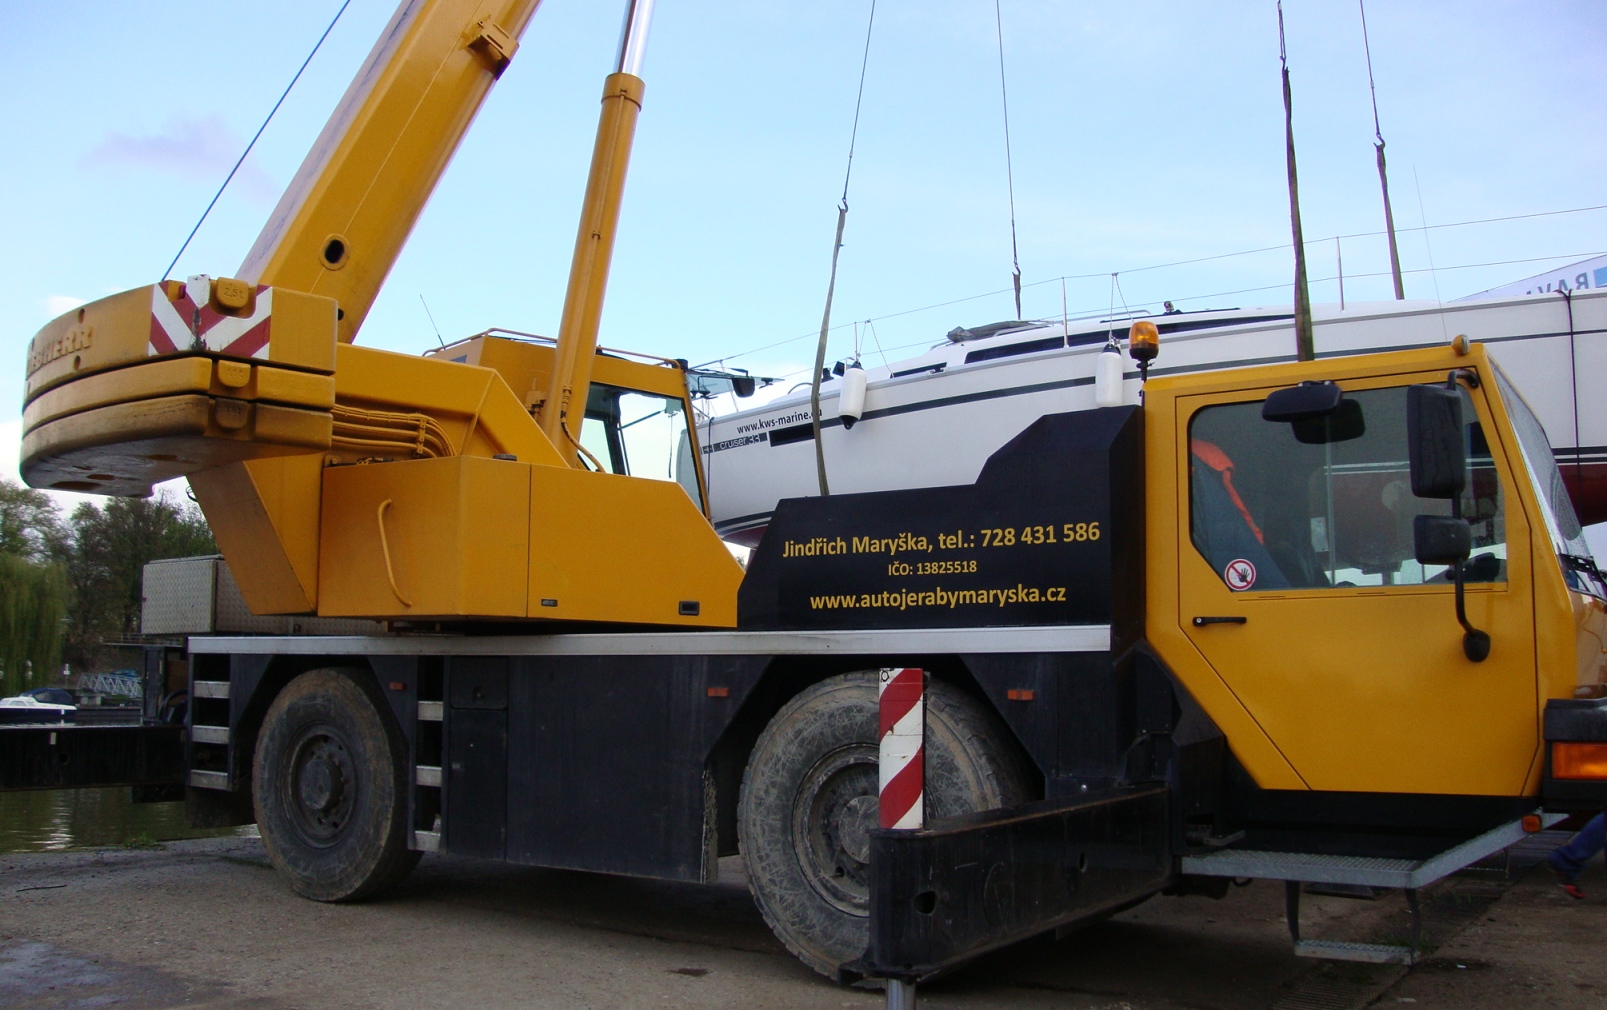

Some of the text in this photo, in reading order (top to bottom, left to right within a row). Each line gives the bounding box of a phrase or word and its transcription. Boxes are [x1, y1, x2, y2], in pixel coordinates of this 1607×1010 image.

[736, 408, 823, 435] www.kws-marine.
[719, 436, 747, 450] cruiser
[782, 521, 1101, 558] Jindřich Maryška, tel.: 728 431 586
[888, 560, 977, 576] IČO: 13825518
[809, 583, 1067, 611] www.autojerabymaryska.cz
